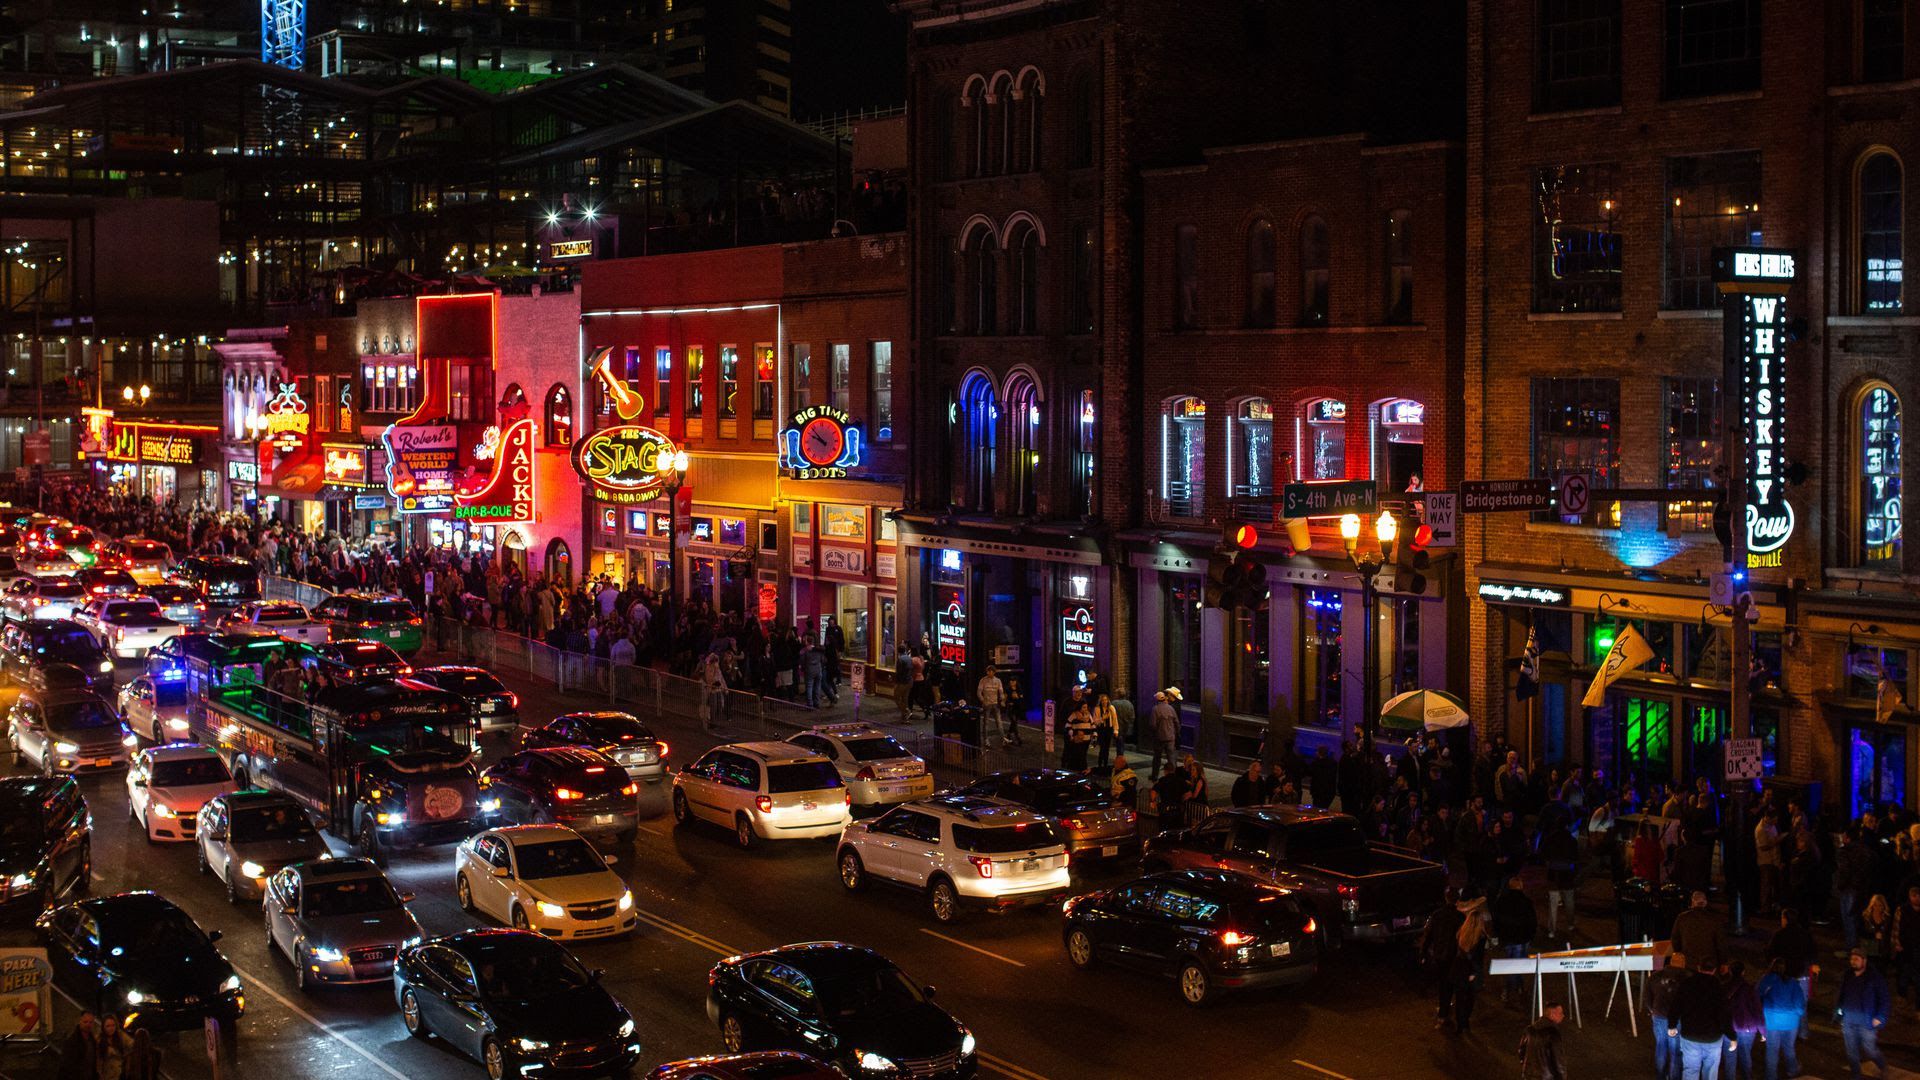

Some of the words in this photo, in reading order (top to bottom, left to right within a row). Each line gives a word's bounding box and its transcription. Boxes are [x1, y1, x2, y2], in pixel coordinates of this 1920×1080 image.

[1753, 298, 1777, 505] WHISKEY
[795, 407, 817, 425] BIG
[819, 405, 850, 424] TIME
[399, 427, 452, 451] Robert's
[620, 429, 639, 439] THE
[141, 441, 165, 457] LEGENDS
[169, 442, 190, 459] GIFTS
[402, 451, 455, 461] WESTERN
[409, 461, 448, 469] WORLD
[415, 471, 448, 480] HOME
[511, 428, 531, 520] JACKS
[800, 467, 847, 479] BOOTS
[1490, 482, 1519, 492] HONORARY
[596, 489, 608, 500] ON
[613, 488, 661, 502] BROADWAY
[1465, 493, 1533, 510] Bridgestone
[1535, 494, 1545, 505] Dr
[1431, 496, 1451, 510] ONE
[455, 505, 512, 519] BAR-B-QUE
[1430, 511, 1452, 525] WAY
[827, 560, 844, 568] BOOTS
[1747, 549, 1783, 568] ASHVILLE
[940, 624, 966, 637] BAILEY'
[1727, 760, 1741, 774] OK
[3, 956, 36, 972] PARK
